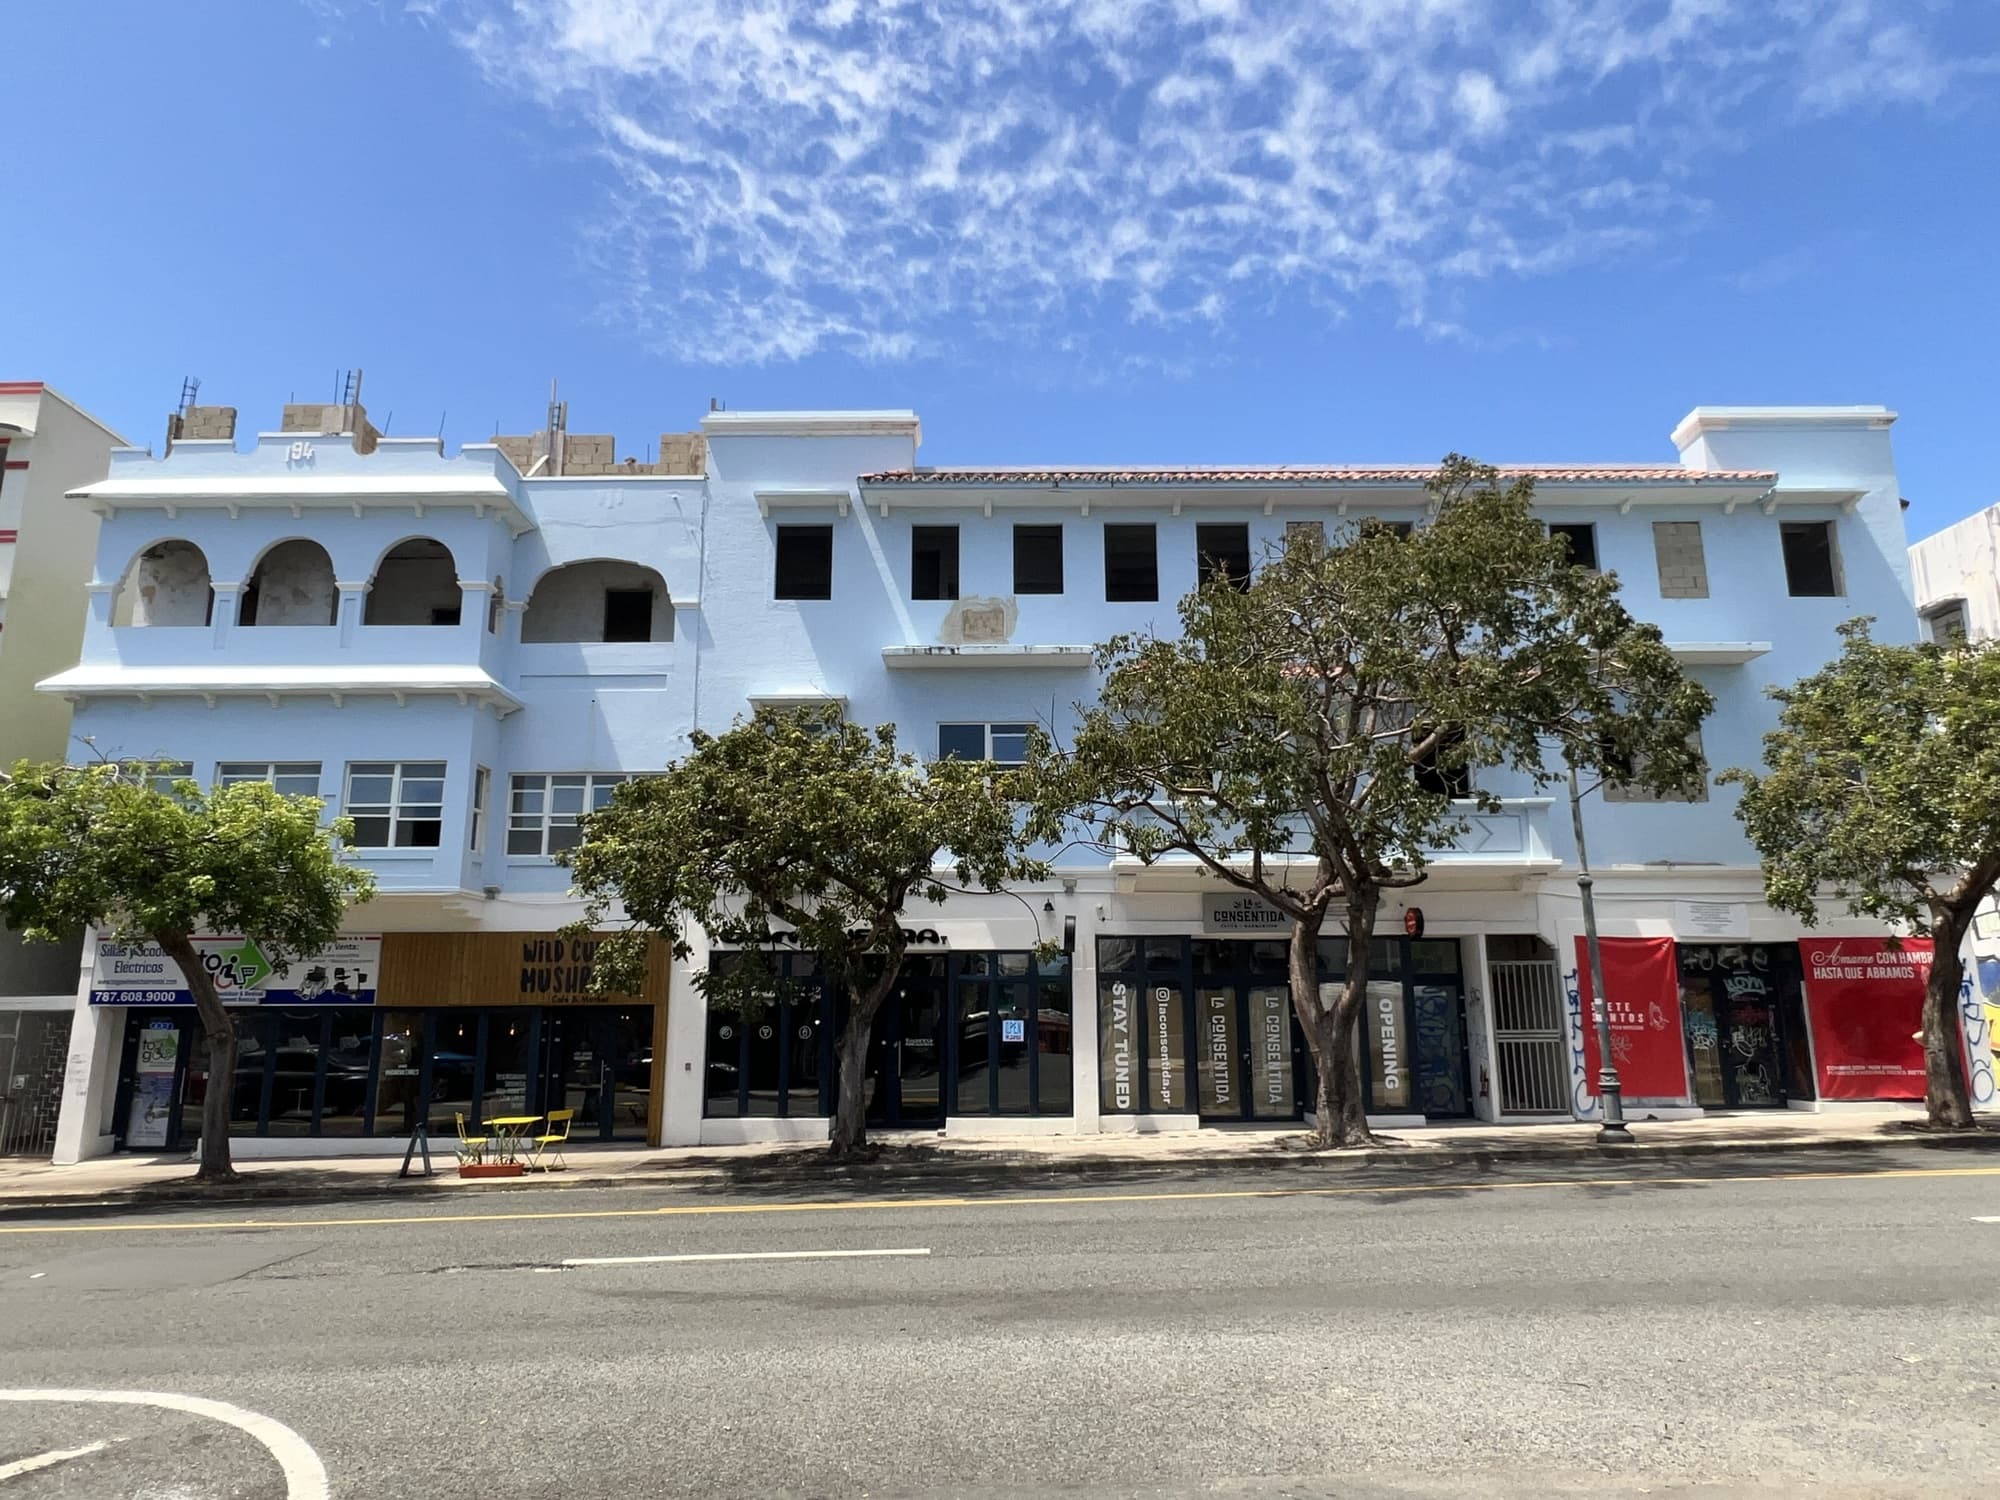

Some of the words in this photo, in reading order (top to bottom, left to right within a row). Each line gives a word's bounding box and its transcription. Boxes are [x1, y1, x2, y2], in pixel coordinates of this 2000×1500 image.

[1243, 898, 1253, 909] LA
[1214, 910, 1286, 922] CONSENTIDA
[101, 944, 127, 957] Sillas
[1876, 951, 1897, 964] CON
[1899, 951, 1934, 964] HAMBR
[1813, 967, 1842, 979] HASTA
[1845, 967, 1865, 979] QUE
[1867, 966, 1914, 979] ABRAMOS
[95, 992, 176, 1002] 787.608.9000
[1211, 997, 1225, 1009] LA
[1266, 997, 1280, 1009] LA
[1112, 983, 1128, 1033] STAY
[1591, 1002, 1630, 1012] SETE
[1379, 998, 1399, 1090] OPENING
[1212, 1015, 1230, 1104] CONSENTIDA
[1266, 1015, 1283, 1104] CONSENTIDA
[1114, 1039, 1131, 1109] TUNED
